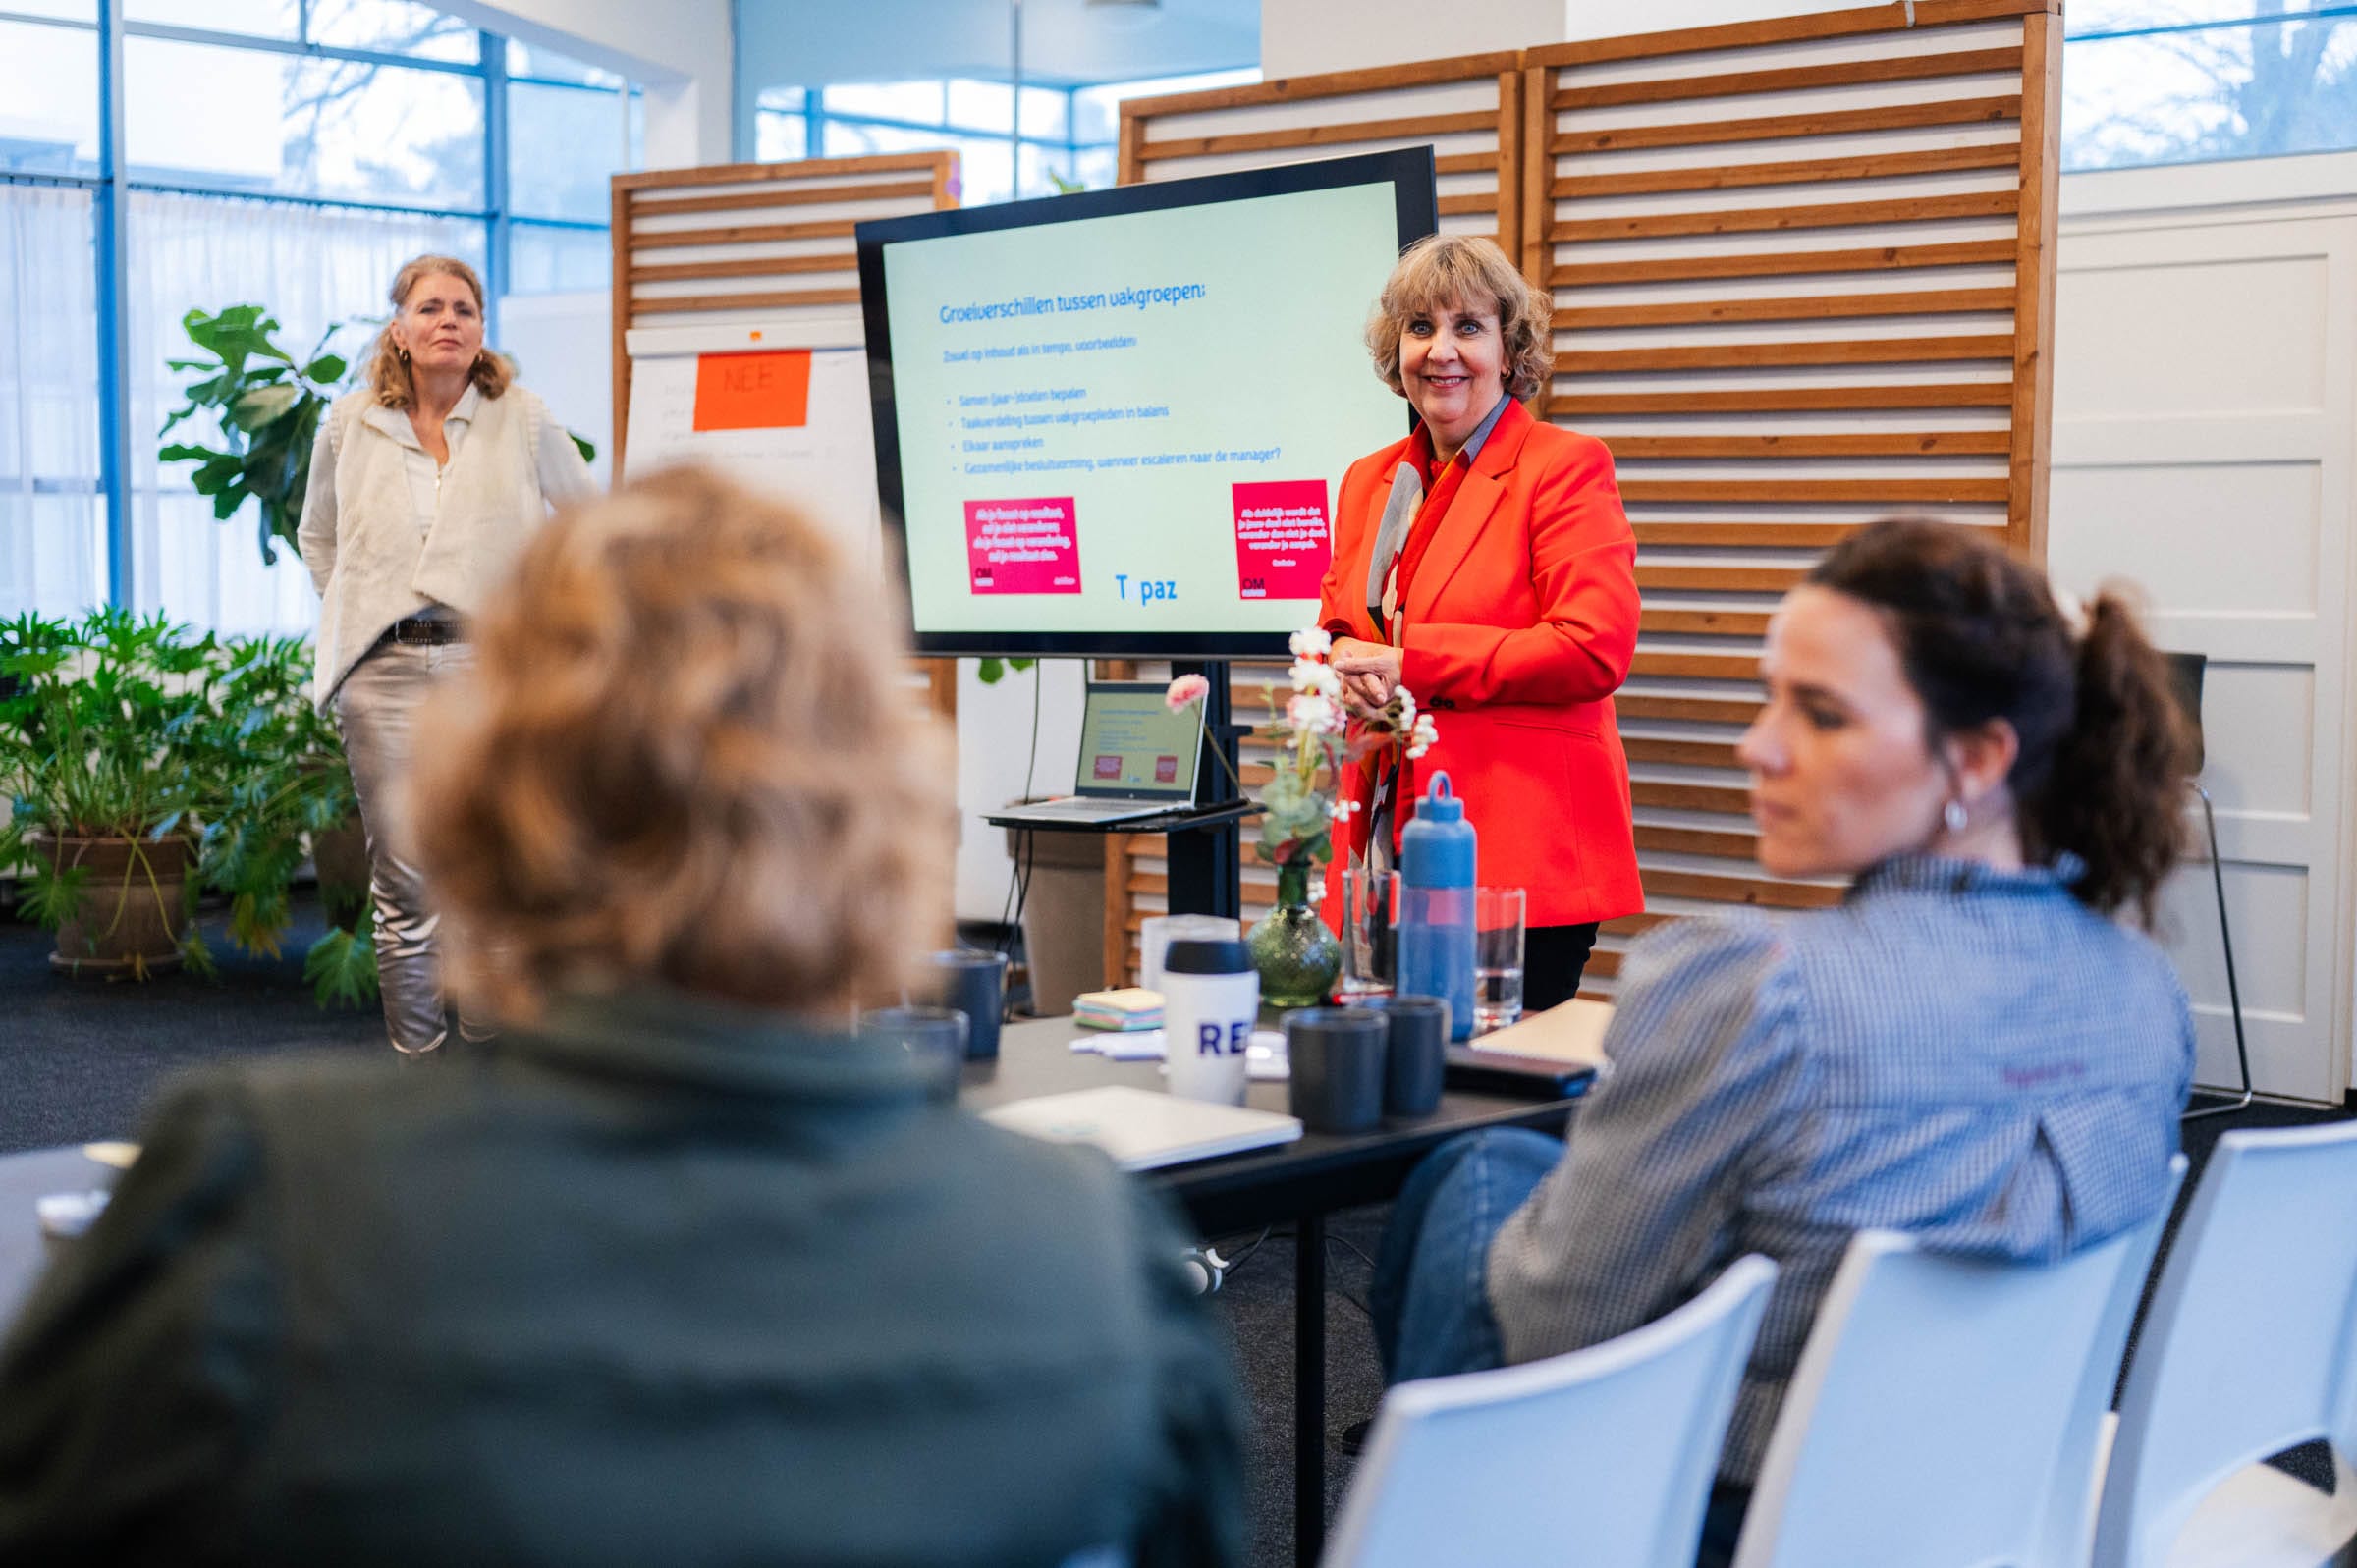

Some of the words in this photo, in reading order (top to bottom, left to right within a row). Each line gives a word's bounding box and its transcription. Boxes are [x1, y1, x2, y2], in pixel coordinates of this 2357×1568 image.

[1058, 293, 1106, 312] tussen
[724, 361, 774, 393] NEE
[1190, 452, 1212, 462] naar
[1216, 450, 1227, 462] de
[1230, 447, 1281, 463] manager?
[1242, 578, 1265, 589] OM
